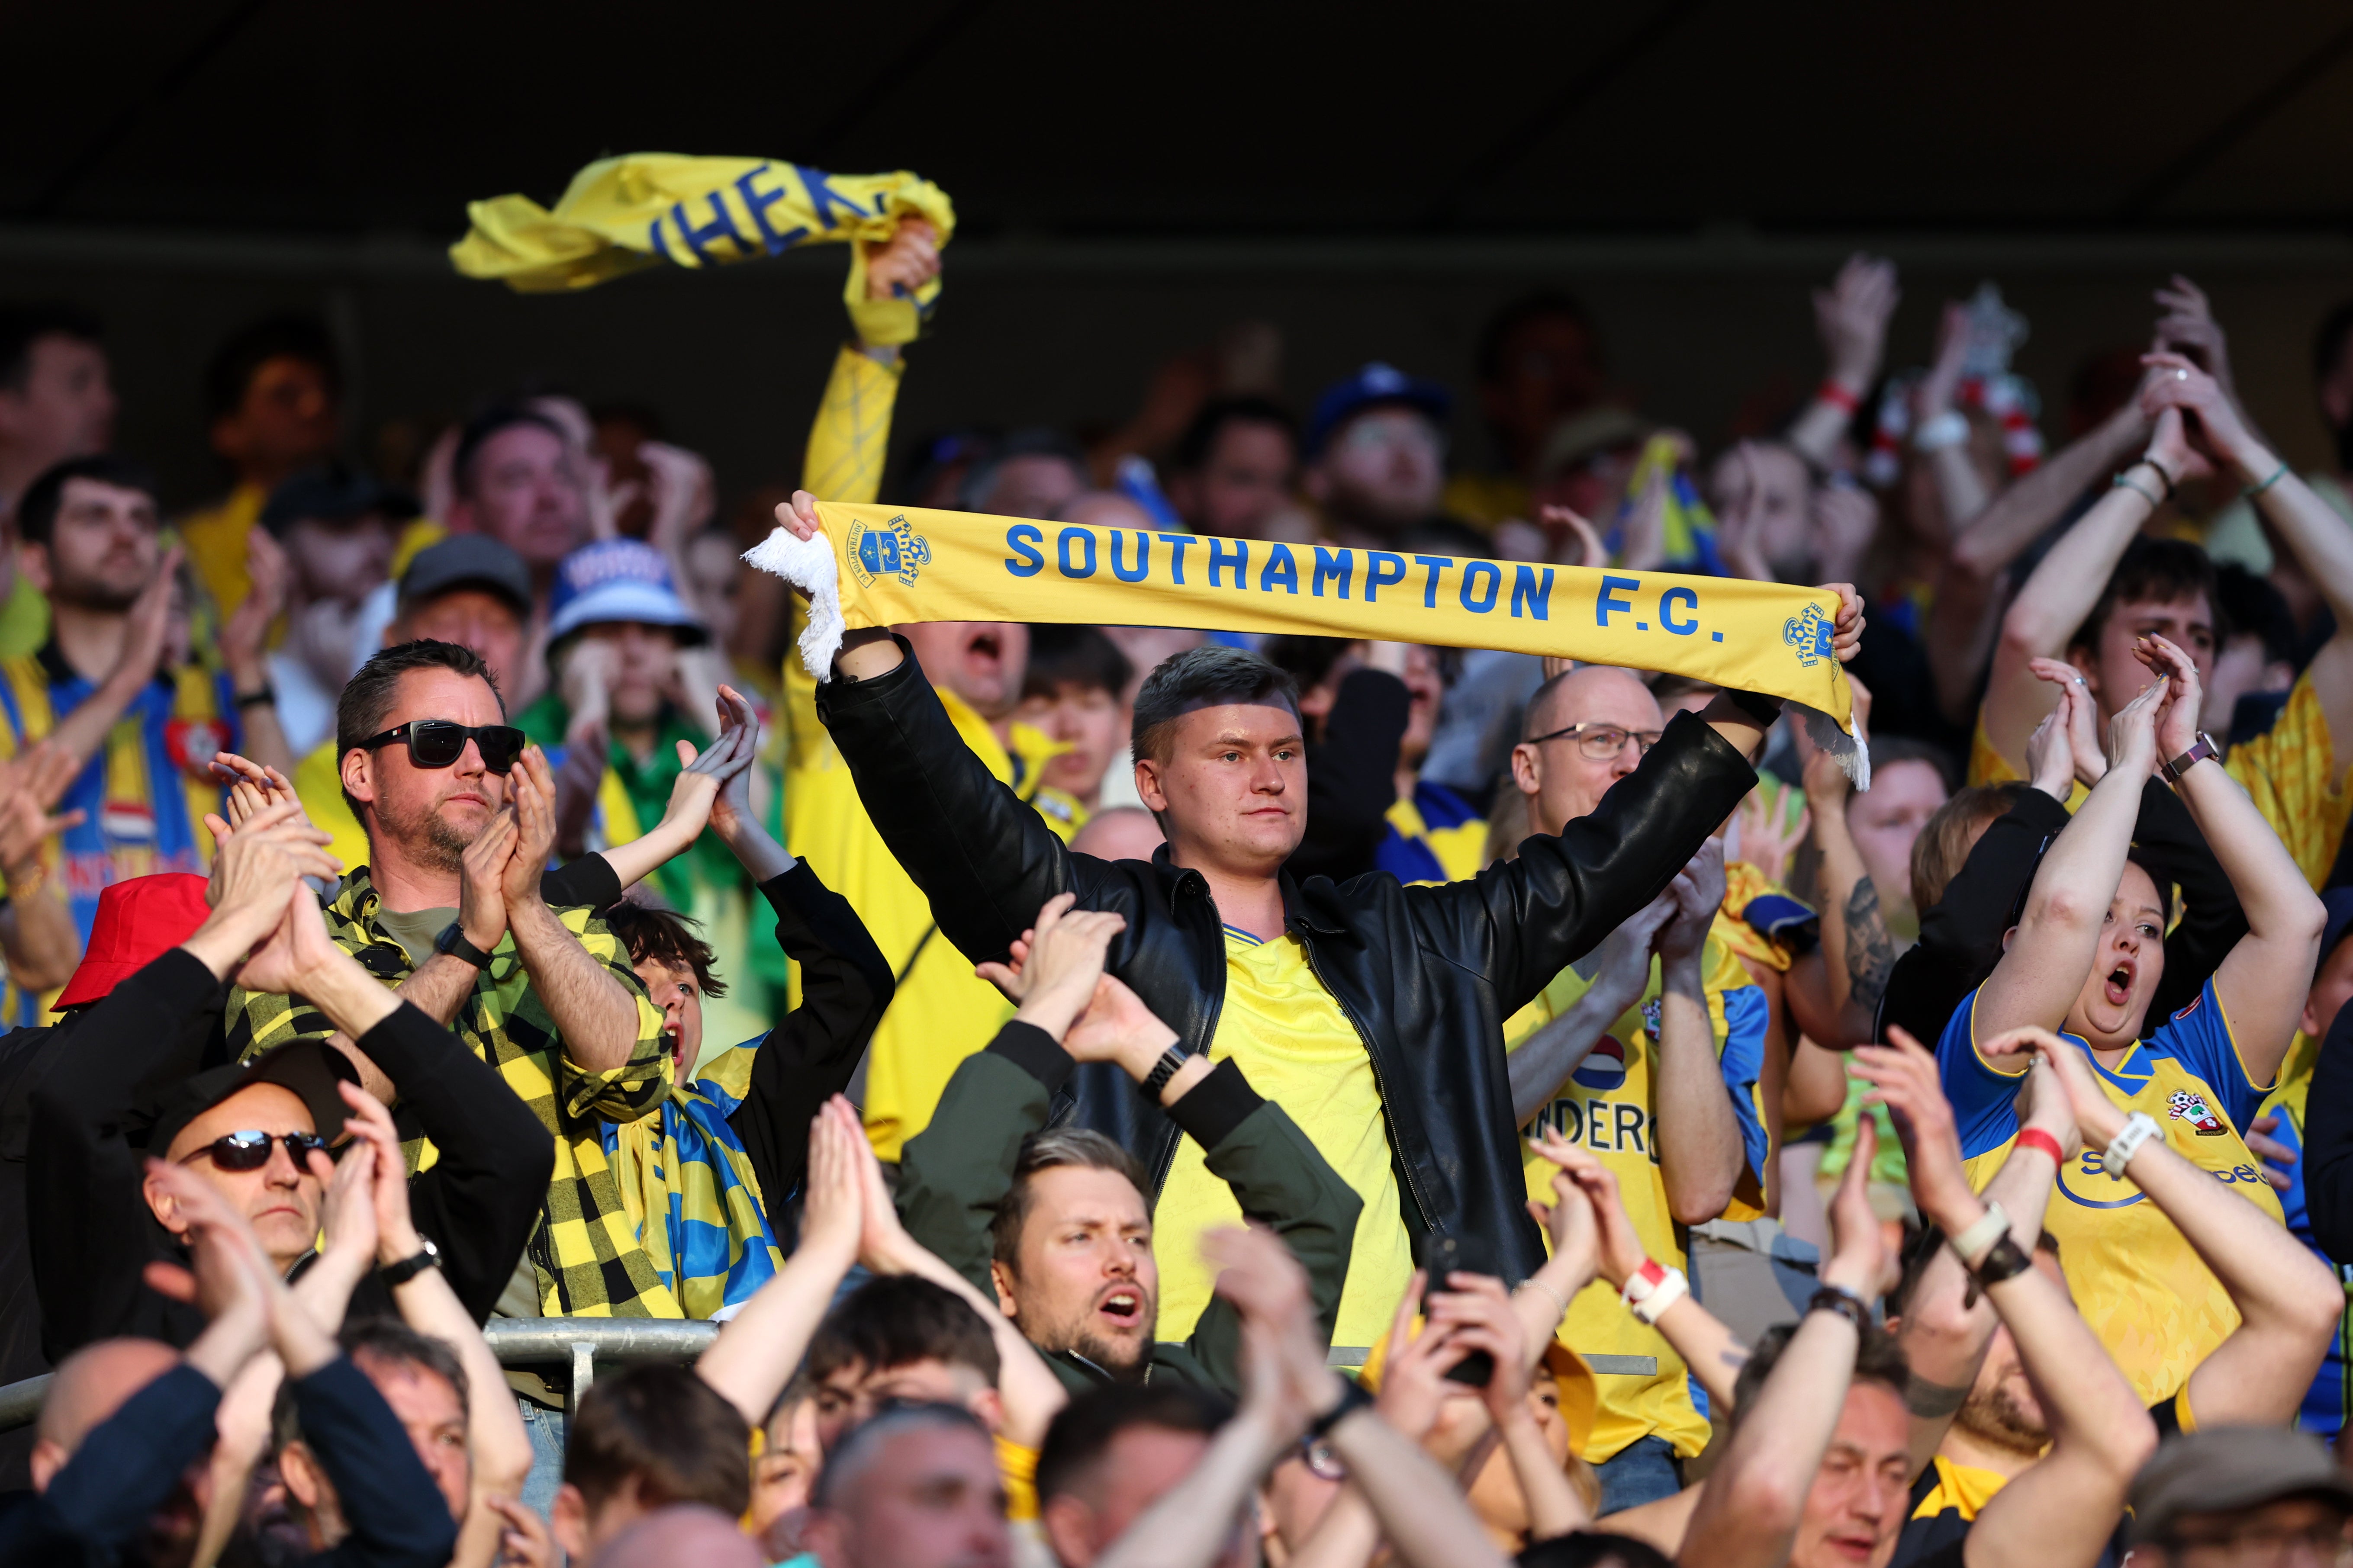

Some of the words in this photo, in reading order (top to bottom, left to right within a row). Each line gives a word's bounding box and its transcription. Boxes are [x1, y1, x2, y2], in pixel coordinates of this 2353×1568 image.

[849, 524, 863, 574] SOUTHAMPTON
[859, 573, 869, 583] FC
[1005, 524, 1555, 621] SOUTHAMPTON
[1596, 575, 1724, 643] F.C.
